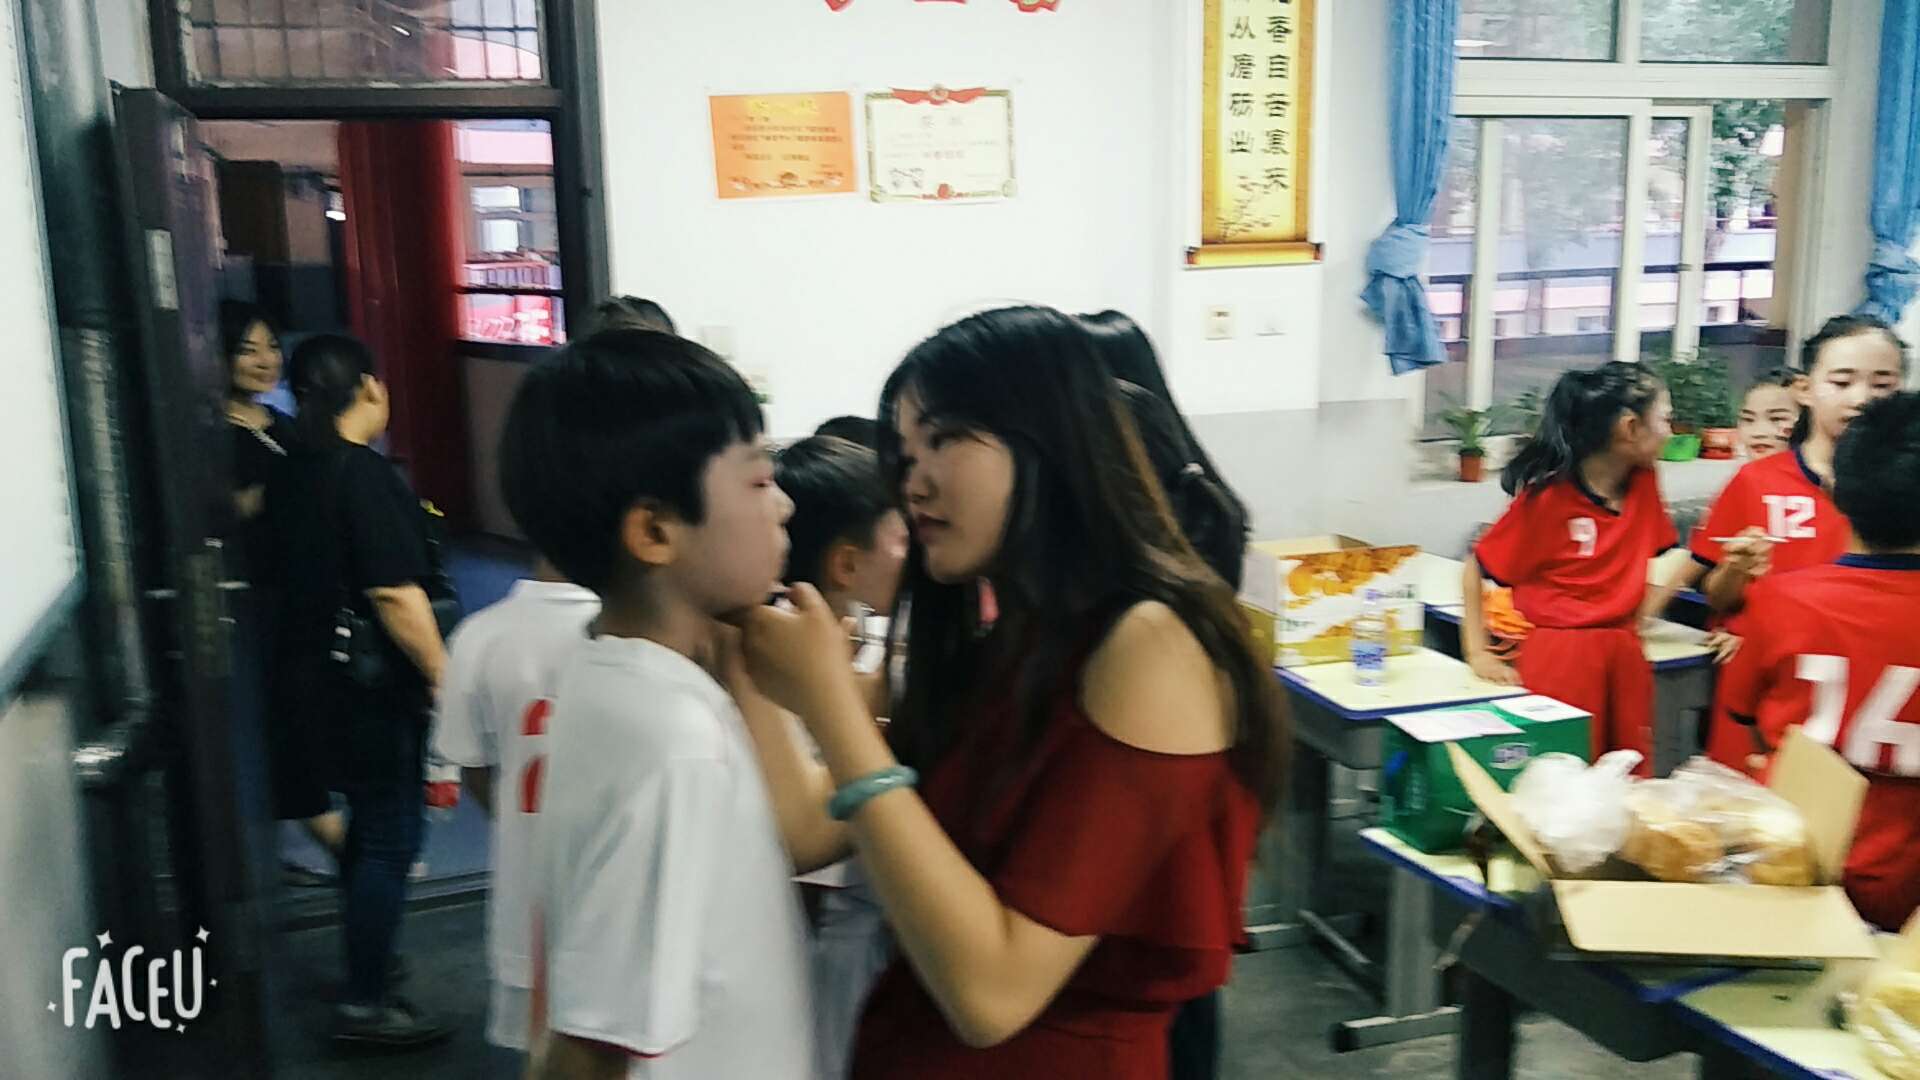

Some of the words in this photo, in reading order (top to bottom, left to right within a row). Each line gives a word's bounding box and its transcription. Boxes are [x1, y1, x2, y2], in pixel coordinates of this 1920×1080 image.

[1228, 0, 1256, 154] 从磨砺出
[1262, 0, 1292, 191] 香自苦寒来
[1762, 495, 1816, 538] 12
